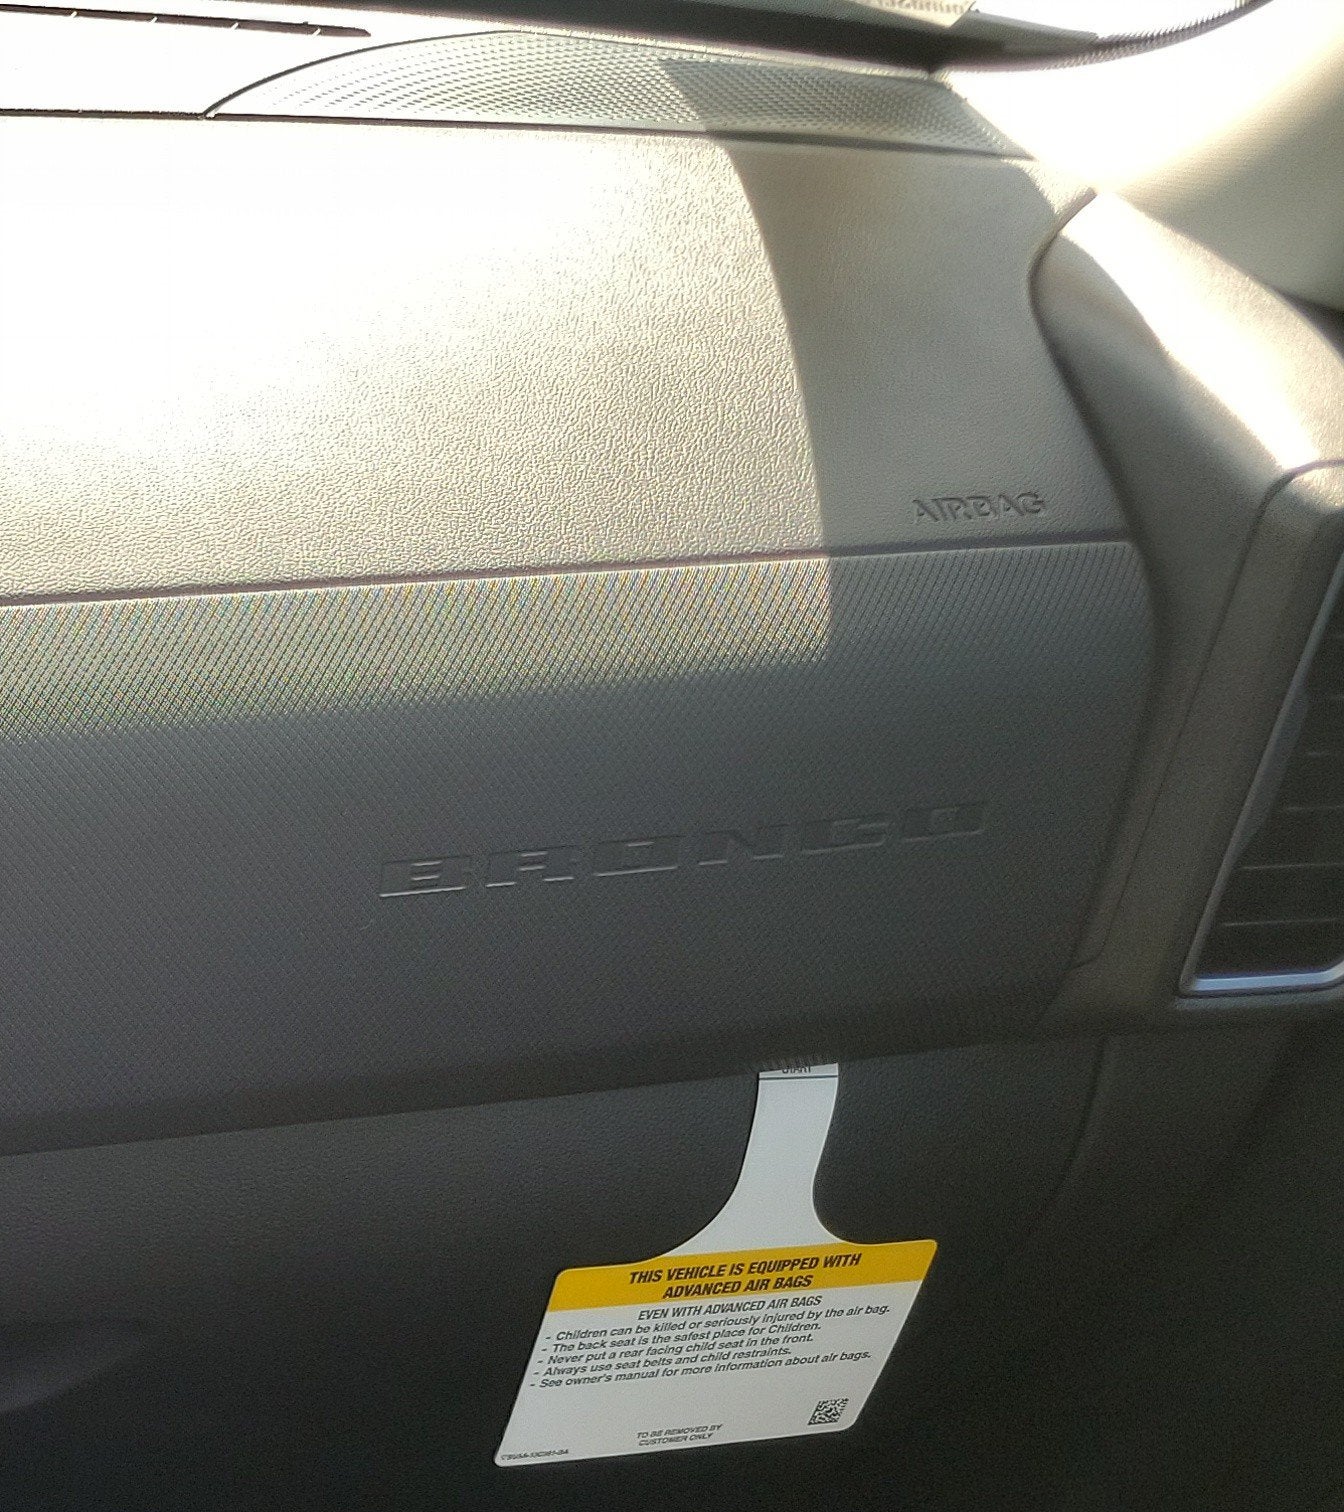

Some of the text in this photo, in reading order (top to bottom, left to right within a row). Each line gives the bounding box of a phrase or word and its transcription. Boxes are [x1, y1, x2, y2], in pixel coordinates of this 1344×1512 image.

[912, 490, 1046, 521] AIRBAG
[379, 801, 993, 897] BRONCO
[629, 1253, 862, 1284] THIS VEHICLE IS EQUIPPED WITH
[663, 1274, 814, 1300] ADVANCED AIR BAGS
[556, 1303, 891, 1342] Children can be killed or seriously injured by the air bag.
[638, 1295, 823, 1321] EVEN WITH ADVANCED AIR BAGS
[548, 1333, 814, 1365] Never put a rear facing child seat in the front.
[553, 1321, 821, 1353] The back seat is the safest place for Children.
[539, 1350, 872, 1388] See owner's manual for more information about air bags.
[544, 1346, 792, 1377] Always use seat belts and child restraints.
[637, 1423, 723, 1439] TO BE REMOVED BY
[639, 1432, 714, 1447] CUSTOMER ONLY
